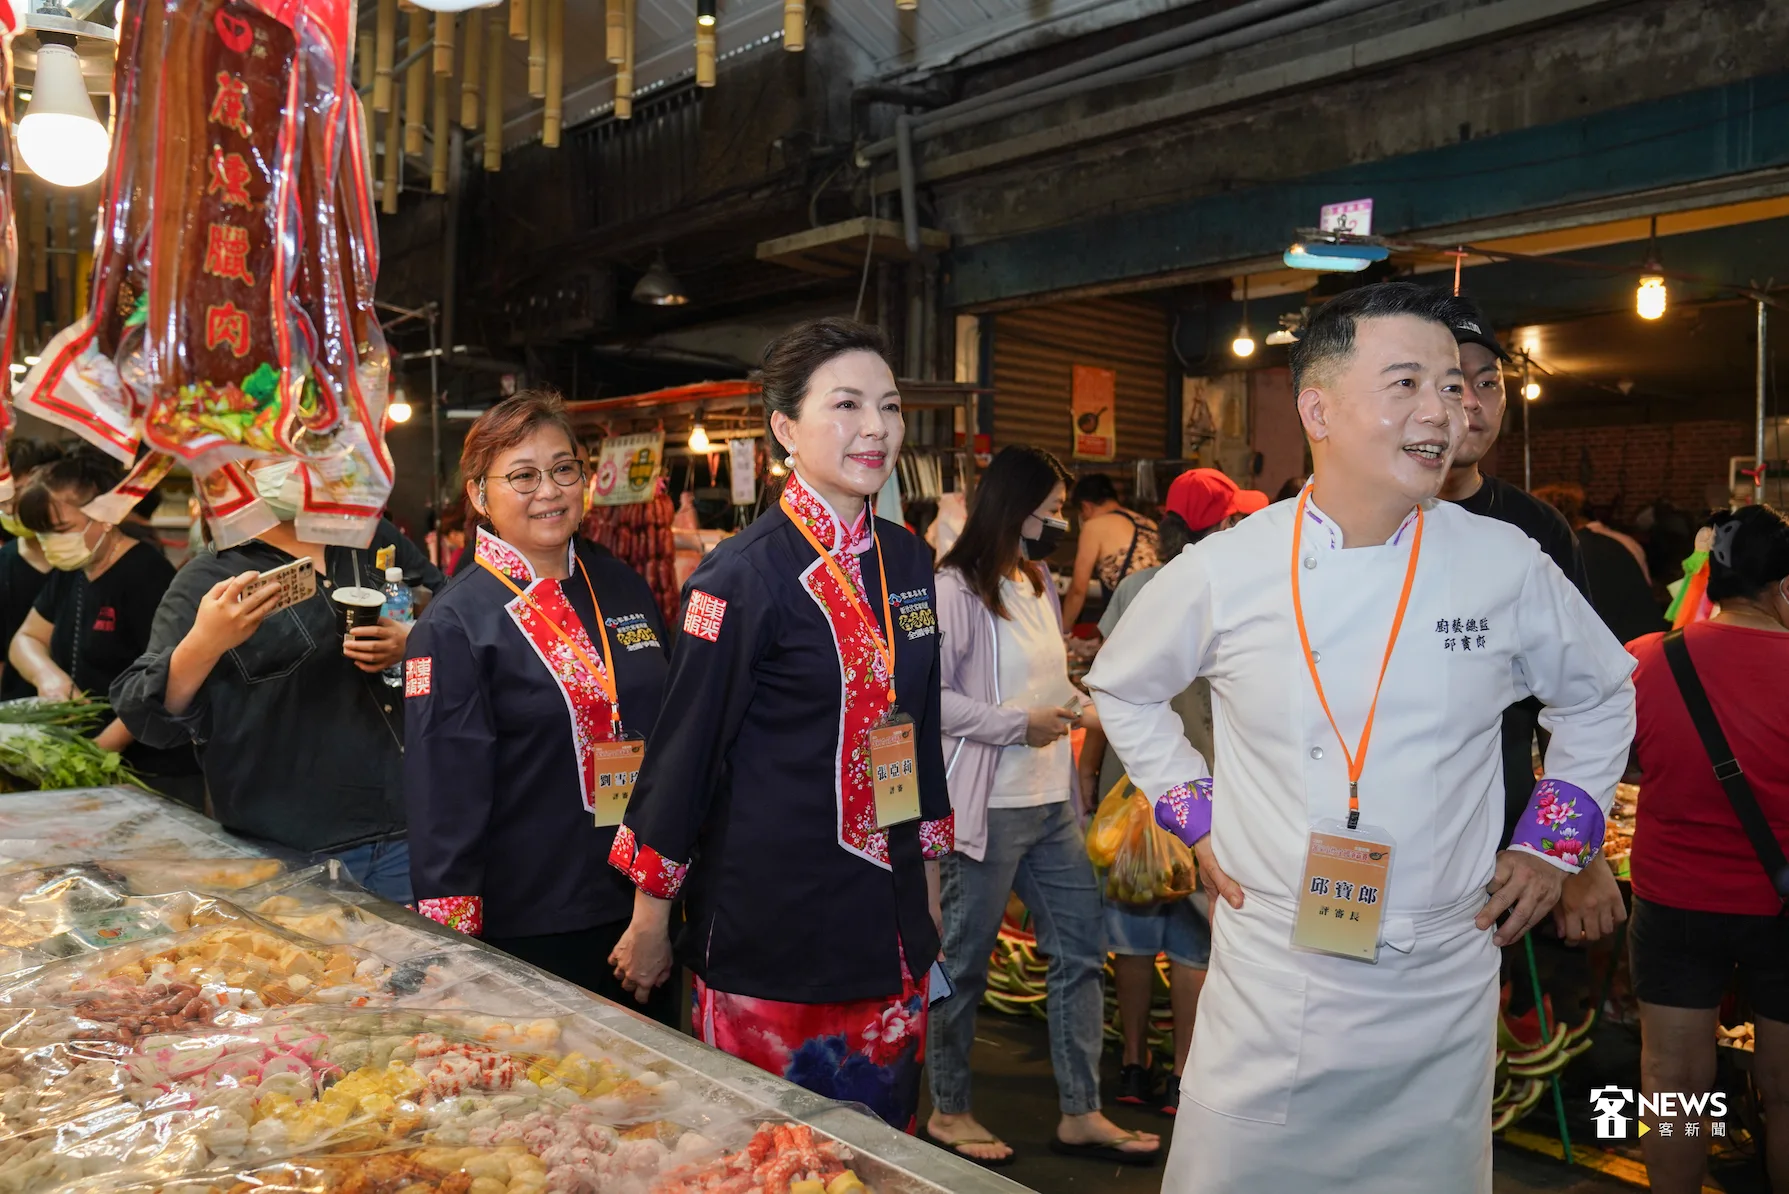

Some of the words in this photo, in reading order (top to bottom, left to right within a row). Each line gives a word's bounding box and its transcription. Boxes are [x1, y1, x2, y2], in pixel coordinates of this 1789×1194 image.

[1435, 617, 1490, 634] 廚藝總監
[877, 758, 913, 783] 張亞莉
[1310, 876, 1379, 905] 邱寶郎
[1319, 906, 1360, 922] 評審長
